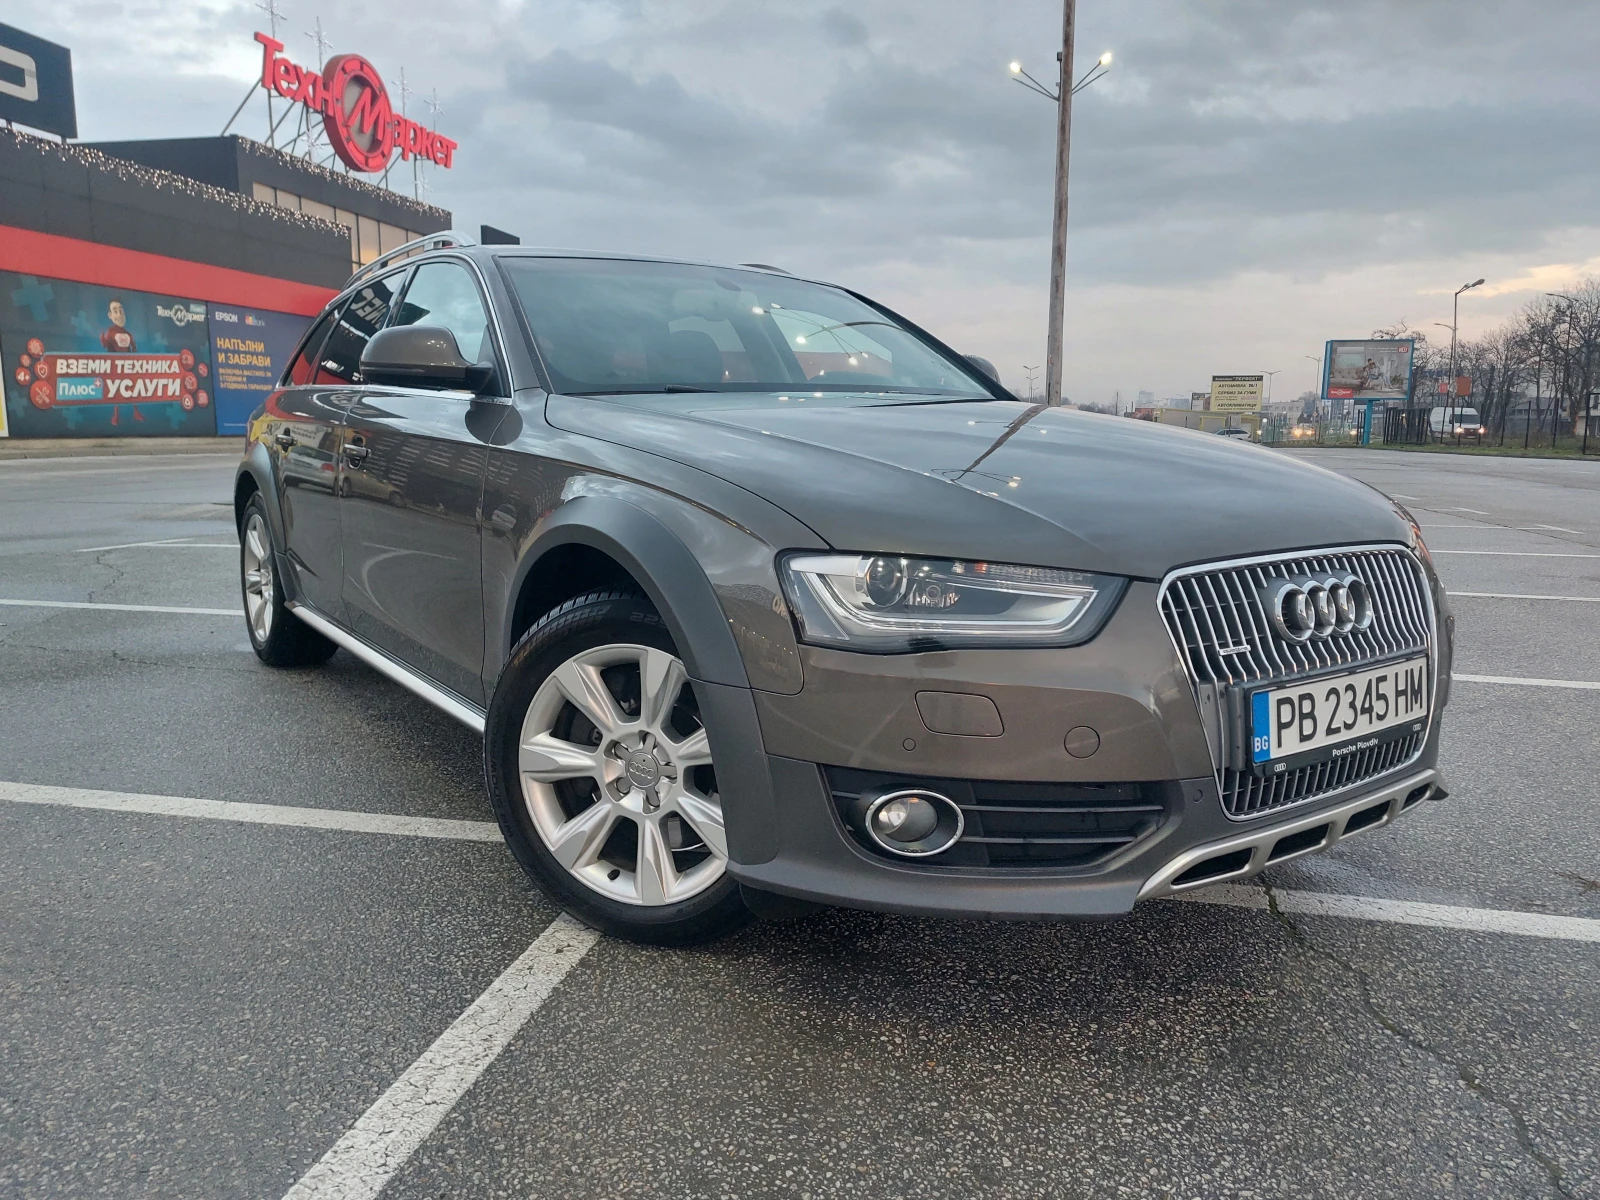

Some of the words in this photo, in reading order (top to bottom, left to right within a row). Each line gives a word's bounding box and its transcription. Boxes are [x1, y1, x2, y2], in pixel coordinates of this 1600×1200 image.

[215, 311, 238, 323] EPSON
[216, 337, 265, 352] НАПЪЛНИ
[56, 358, 111, 374] ВЗЕМИ
[115, 359, 181, 374] ТЕХНИКА
[218, 352, 225, 363] И
[227, 353, 271, 367] ЗАБРАВИ
[106, 377, 181, 399] УСЛУГИ
[1276, 692, 1318, 749] PB
[1325, 674, 1389, 737] 2345
[1395, 665, 1423, 717] HM
[1254, 735, 1269, 753] BG
[1332, 744, 1357, 757] Porsche
[1357, 737, 1379, 750] Plovdiv
